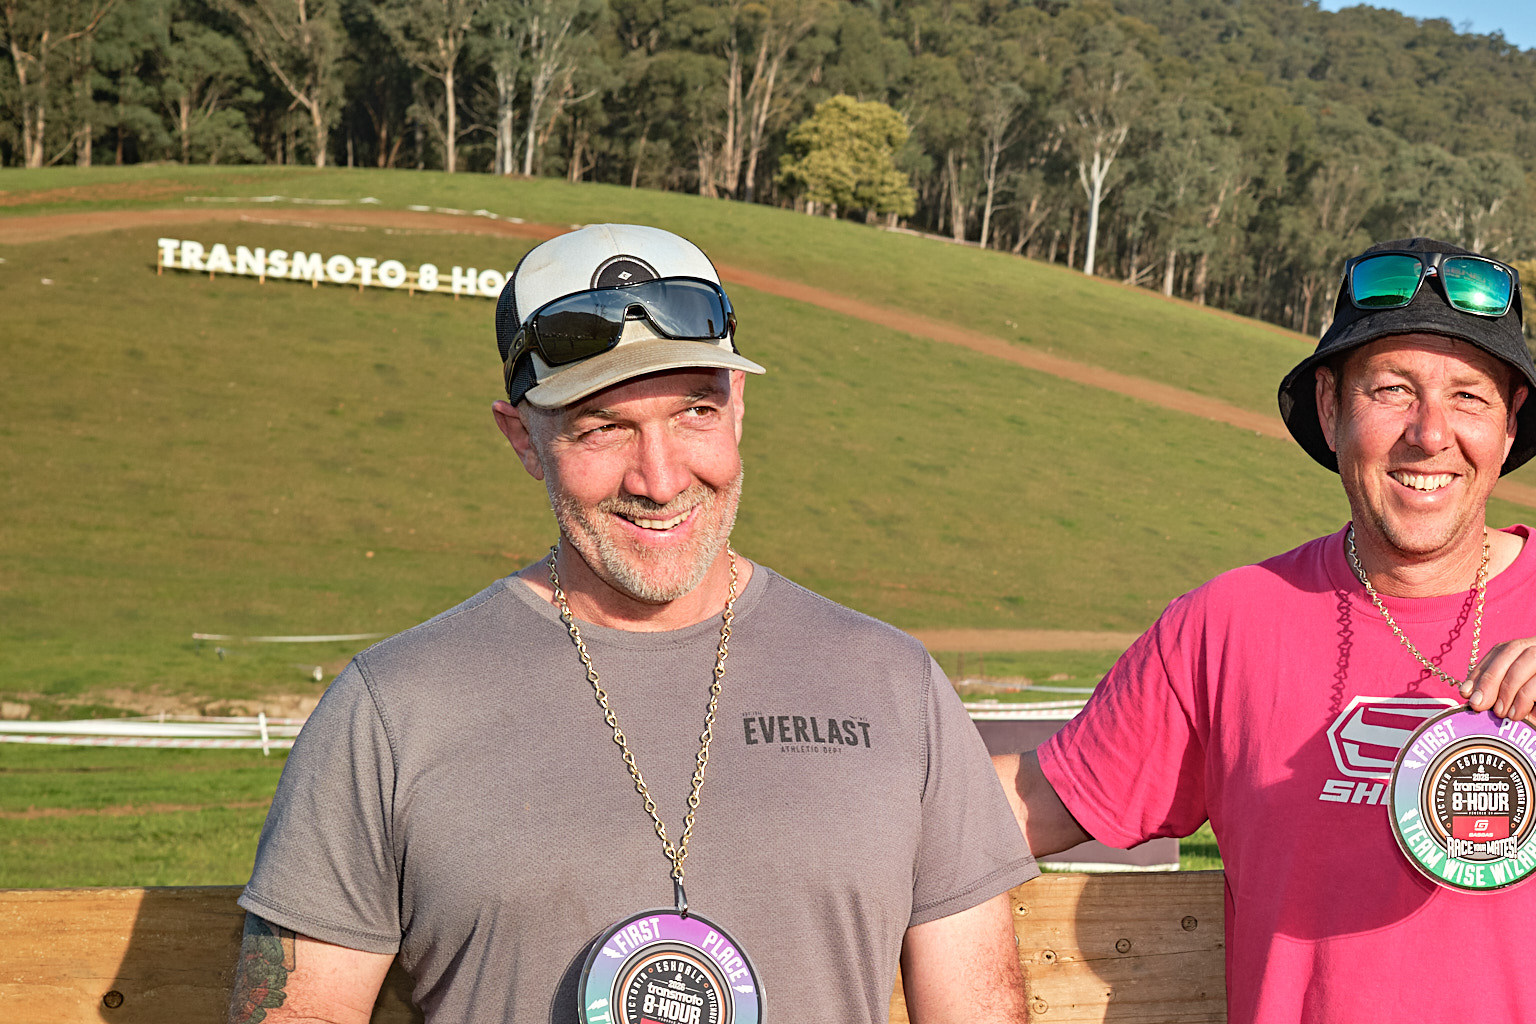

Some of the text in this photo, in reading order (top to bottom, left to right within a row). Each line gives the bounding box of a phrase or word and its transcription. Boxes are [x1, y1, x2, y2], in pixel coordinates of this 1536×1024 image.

[157, 237, 514, 297] TRANSMOTO 8 HO
[743, 716, 871, 748] EVERLAST
[1412, 718, 1458, 762] FIRST
[1319, 779, 1389, 805] SH
[1437, 773, 1452, 821] VICTORIA
[1452, 792, 1510, 812] 8-HOUR
[1453, 780, 1510, 792] transmoto
[1403, 821, 1444, 869] TEAM
[1443, 859, 1486, 886] WISE
[1446, 836, 1474, 860] RACE
[1486, 835, 1518, 859] MATES!
[613, 917, 749, 983] FIRST PLACE
[628, 972, 648, 1020] VICTORIA
[647, 982, 704, 1006] transmoto
